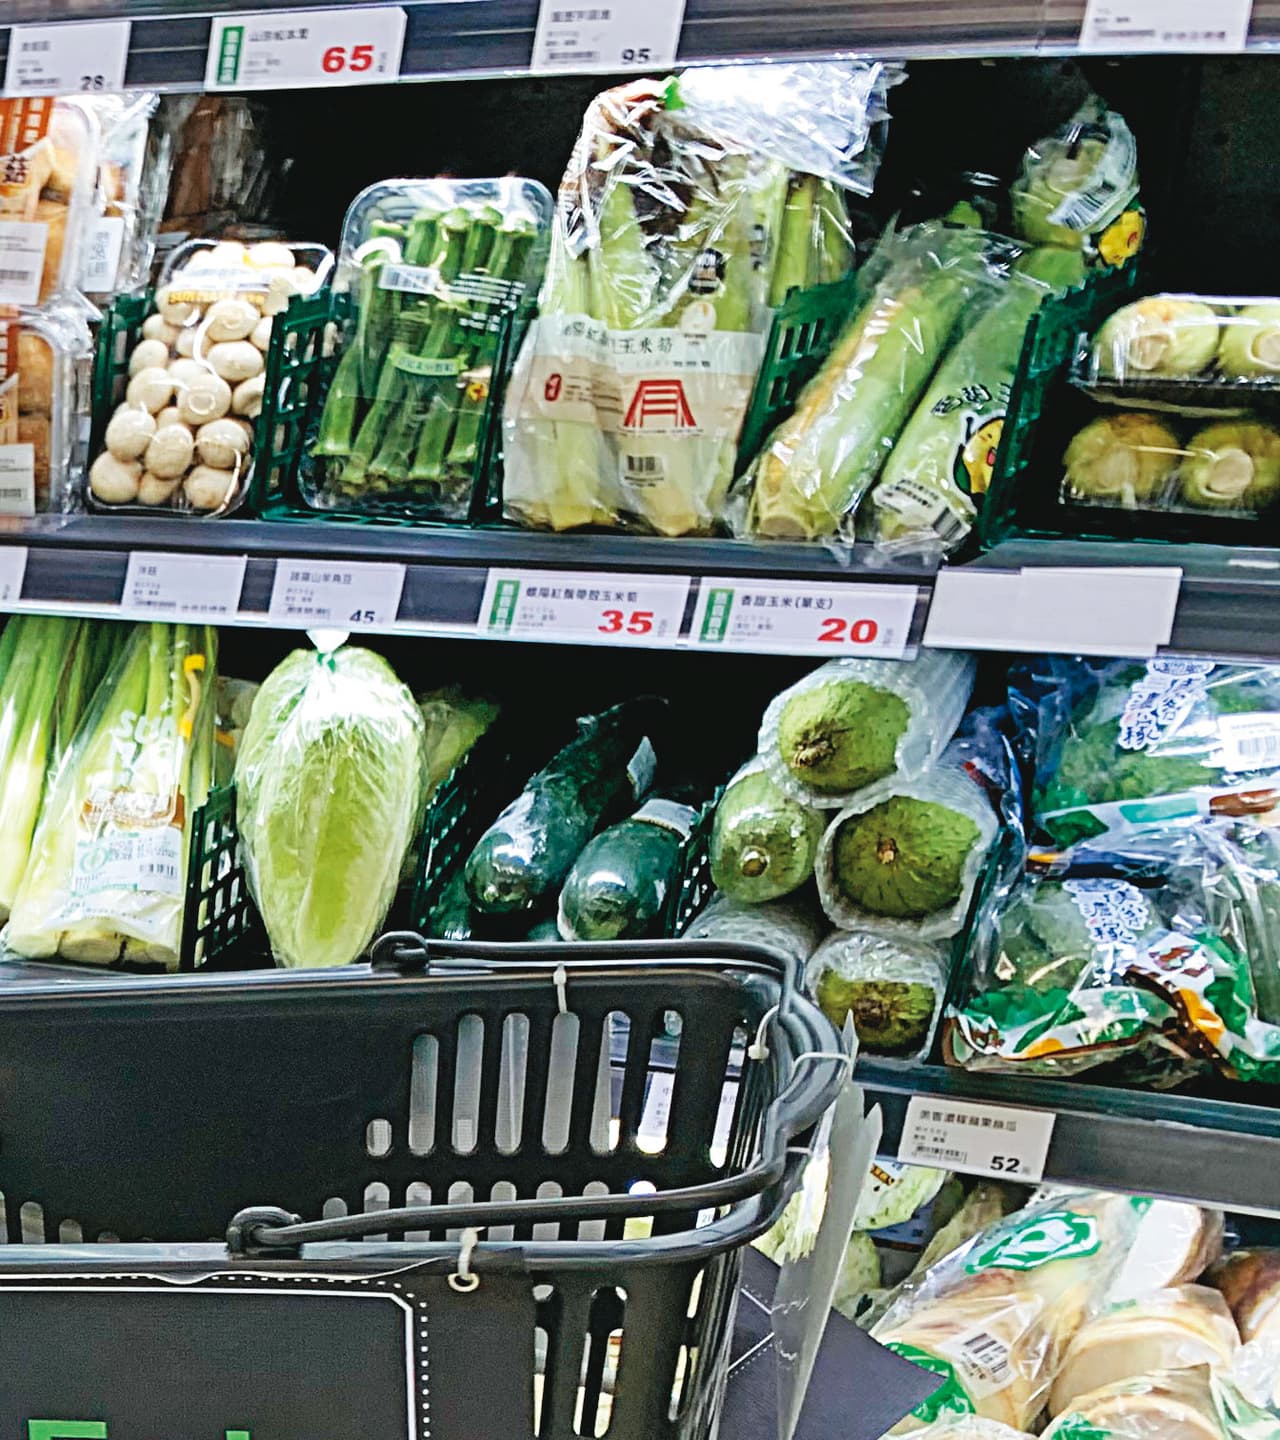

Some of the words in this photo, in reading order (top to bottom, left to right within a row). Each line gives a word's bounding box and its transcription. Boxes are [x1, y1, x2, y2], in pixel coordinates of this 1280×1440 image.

[321, 45, 374, 73] 65
[620, 48, 650, 65] 95
[350, 610, 376, 624] 45
[597, 609, 655, 635] 35
[817, 618, 878, 644] 20
[990, 1155, 1020, 1173] 52
